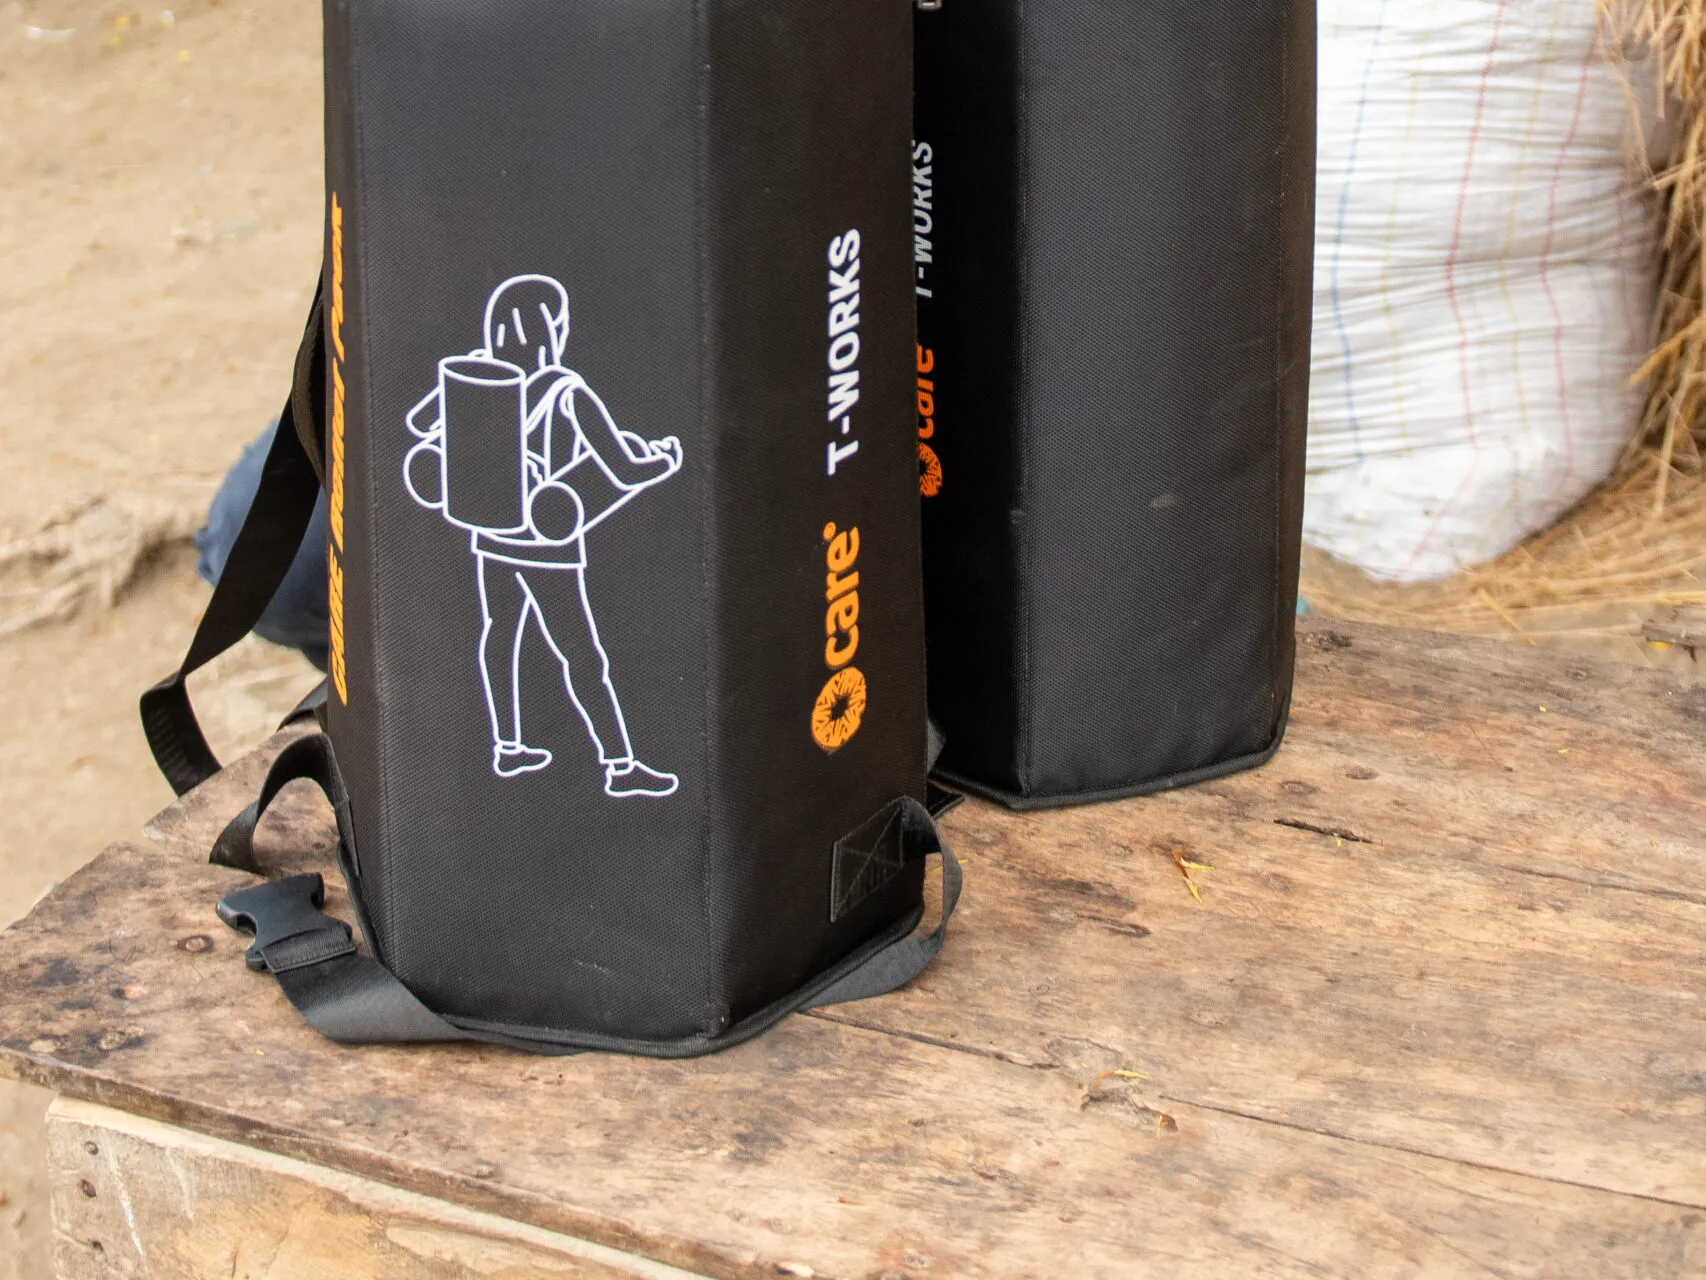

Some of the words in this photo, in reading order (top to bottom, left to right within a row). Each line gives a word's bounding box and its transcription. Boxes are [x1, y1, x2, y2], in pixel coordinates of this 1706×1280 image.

[330, 192, 345, 363] Pack
[827, 228, 861, 476] T-WORKS
[329, 544, 347, 707] CARE
